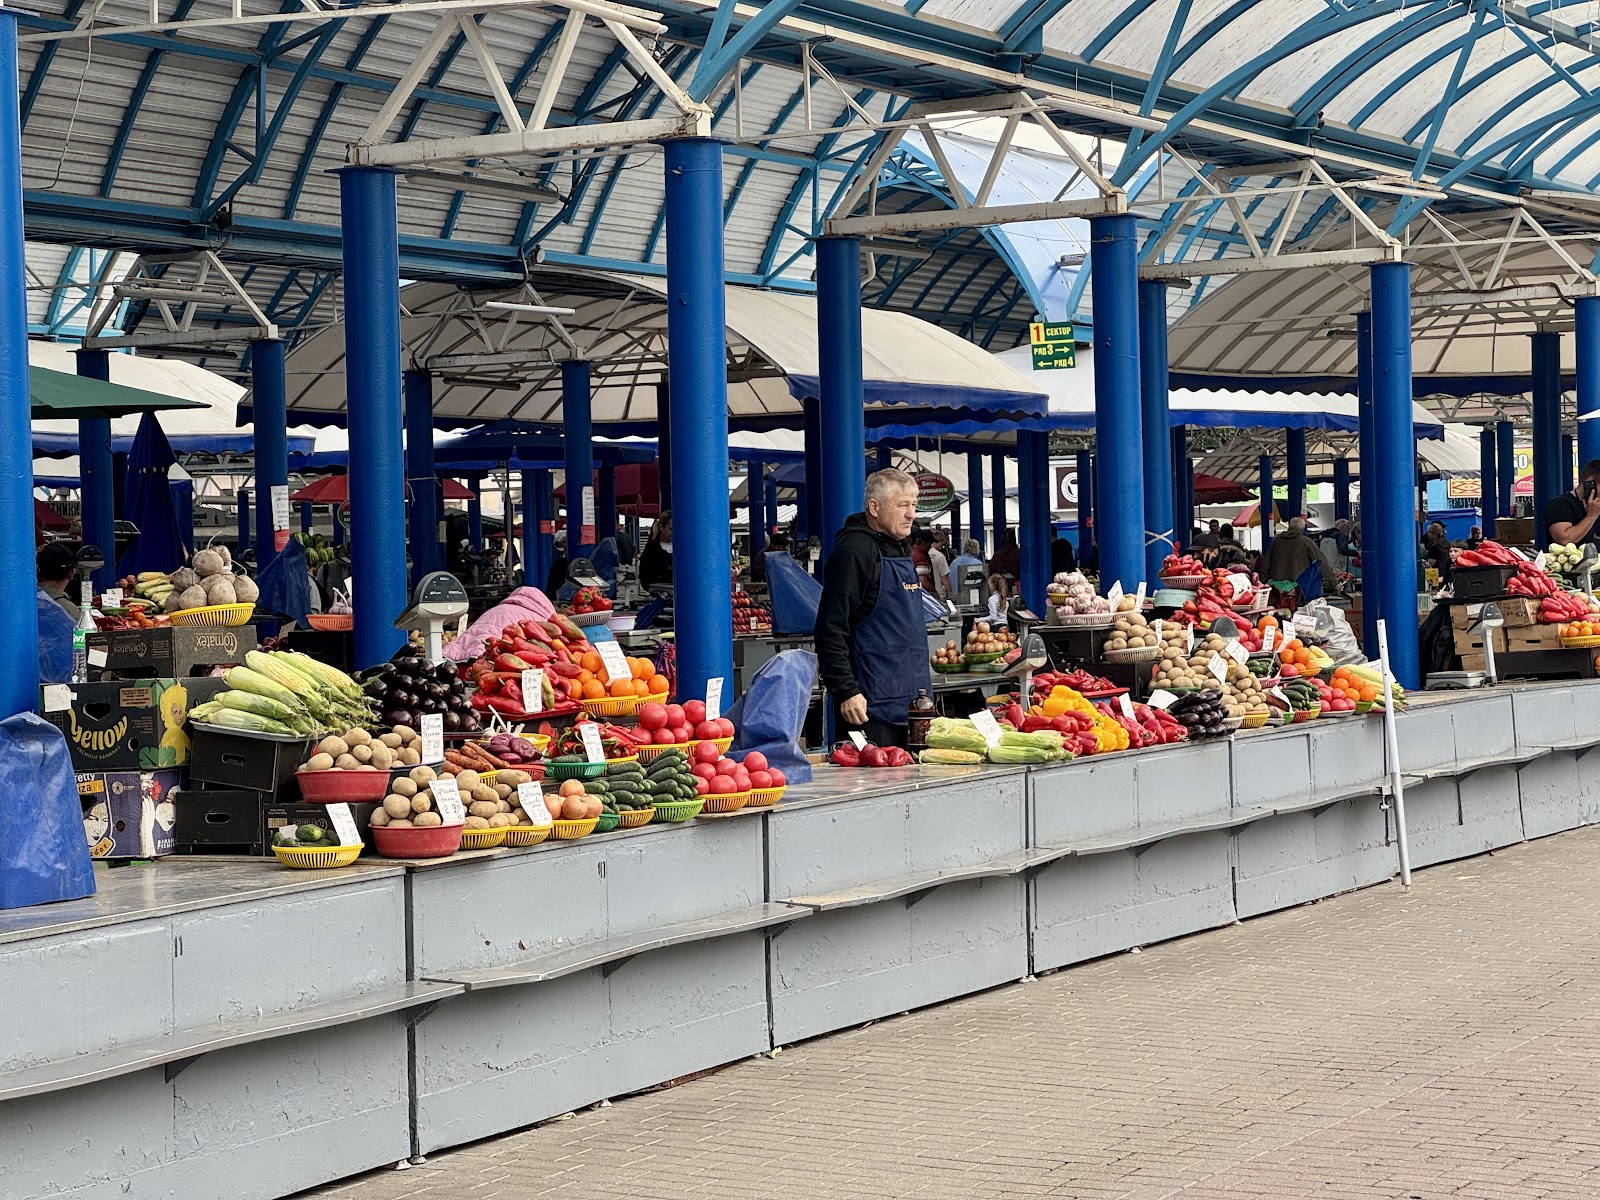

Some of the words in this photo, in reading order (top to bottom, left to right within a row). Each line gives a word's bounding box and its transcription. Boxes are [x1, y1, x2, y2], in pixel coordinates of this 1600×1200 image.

[1033, 325, 1041, 342] 1
[1046, 327, 1071, 336] СЕКТОР
[1034, 347, 1047, 356] РЯД
[1047, 344, 1054, 355] 3
[1054, 359, 1067, 368] РЯД
[1067, 356, 1074, 367] 4
[196, 634, 238, 648] tomatex
[76, 747, 99, 760] PREMIUM
[74, 773, 95, 783] retty
